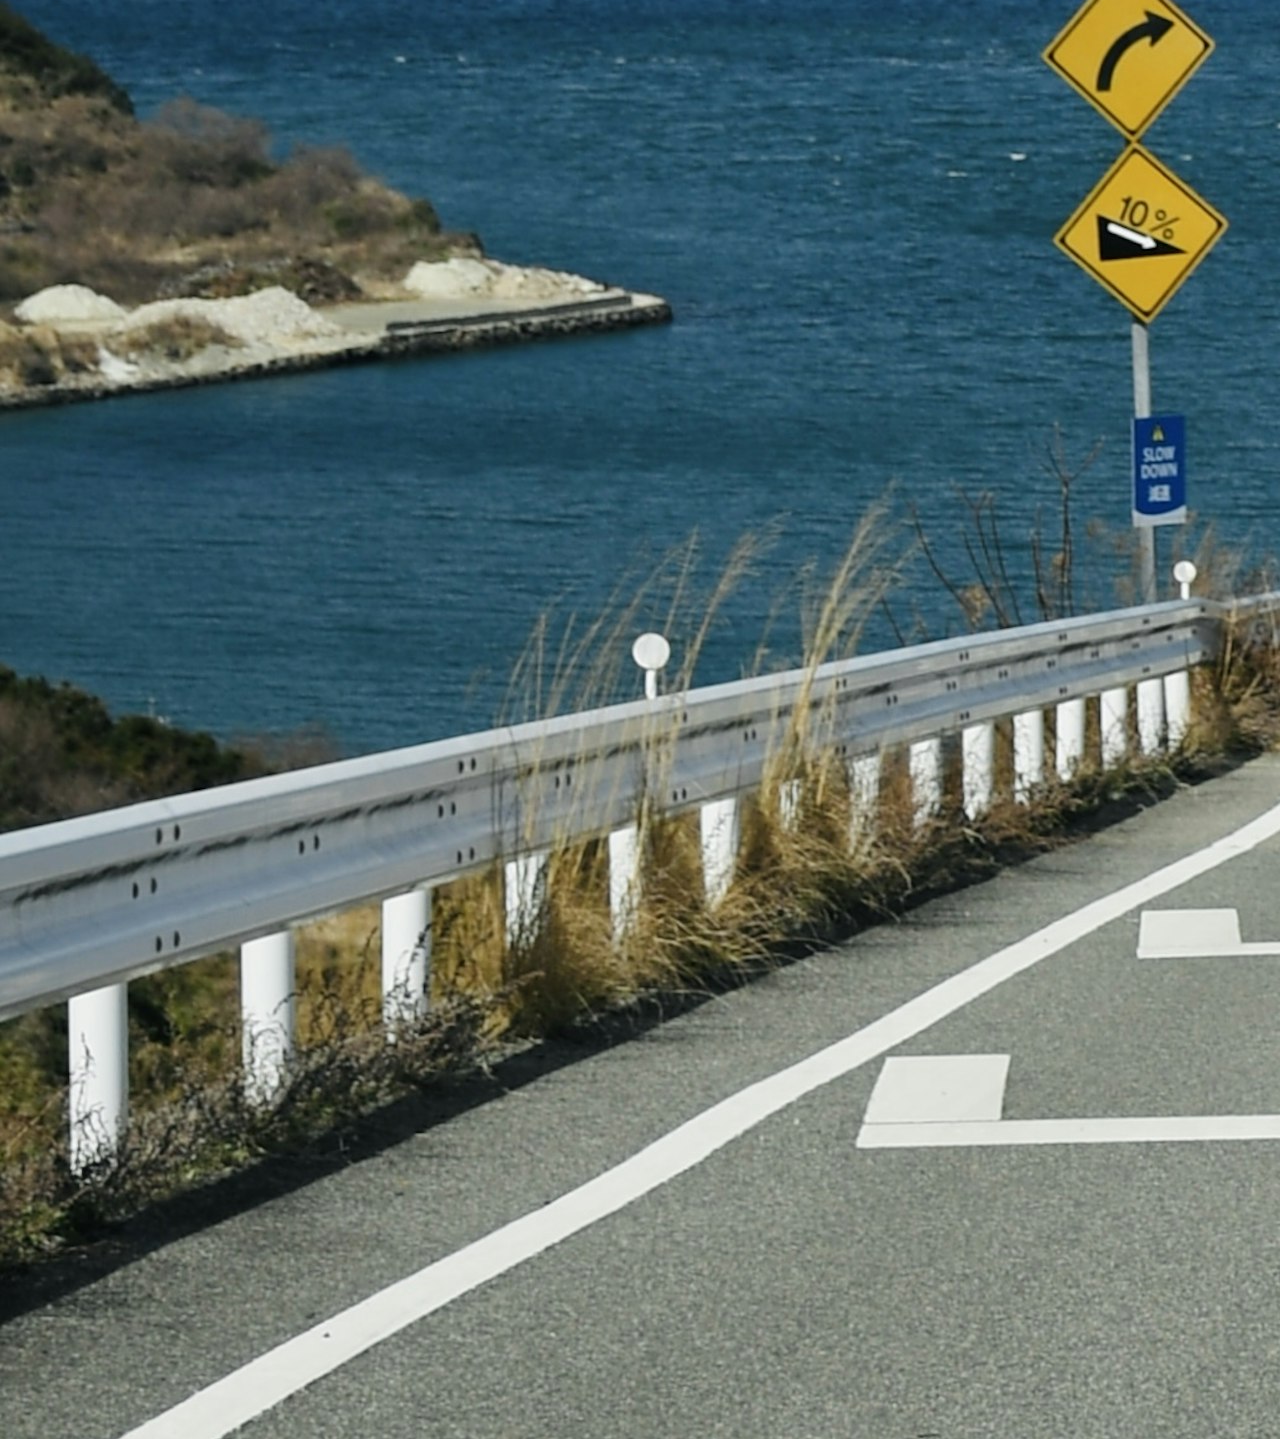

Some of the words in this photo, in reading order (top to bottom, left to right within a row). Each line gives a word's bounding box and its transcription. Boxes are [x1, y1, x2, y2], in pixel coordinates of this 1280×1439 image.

[1119, 195, 1180, 240] 10%
[1143, 446, 1176, 462] SLOW
[1141, 462, 1178, 479] DOWN
